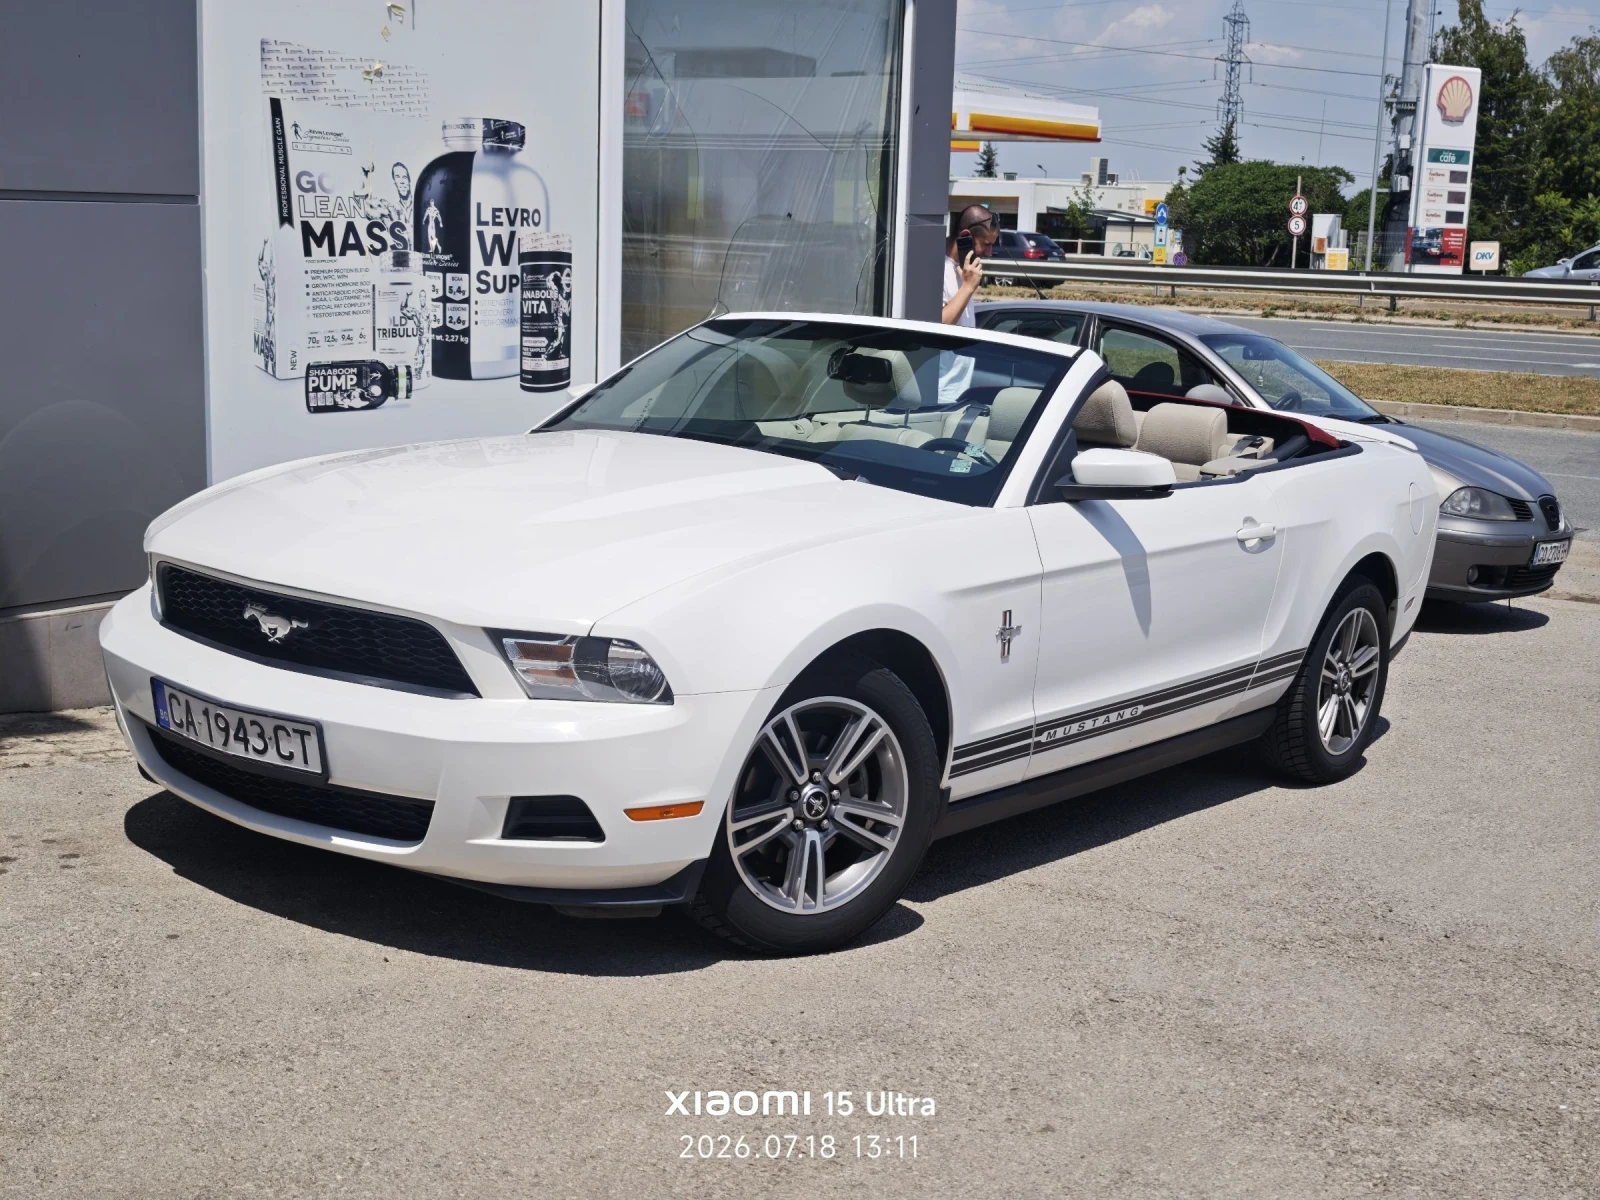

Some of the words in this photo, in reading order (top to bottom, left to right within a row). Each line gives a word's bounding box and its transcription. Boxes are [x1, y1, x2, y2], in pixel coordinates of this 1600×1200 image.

[276, 136, 284, 164] MUSCLE
[280, 165, 288, 217] PROFESSIONAL
[298, 195, 366, 218] LEAN
[1294, 220, 1300, 230] 5
[300, 220, 409, 257] MASS
[1475, 252, 1494, 260] DKV
[522, 300, 548, 314] VITA
[377, 327, 424, 338] TRIBULUS
[460, 335, 469, 344] kg
[253, 332, 275, 362] MASS
[309, 368, 357, 376] SHAABOOM
[308, 375, 357, 391] PUMP
[159, 708, 169, 721] BG
[1045, 706, 1140, 741] MUSTANG
